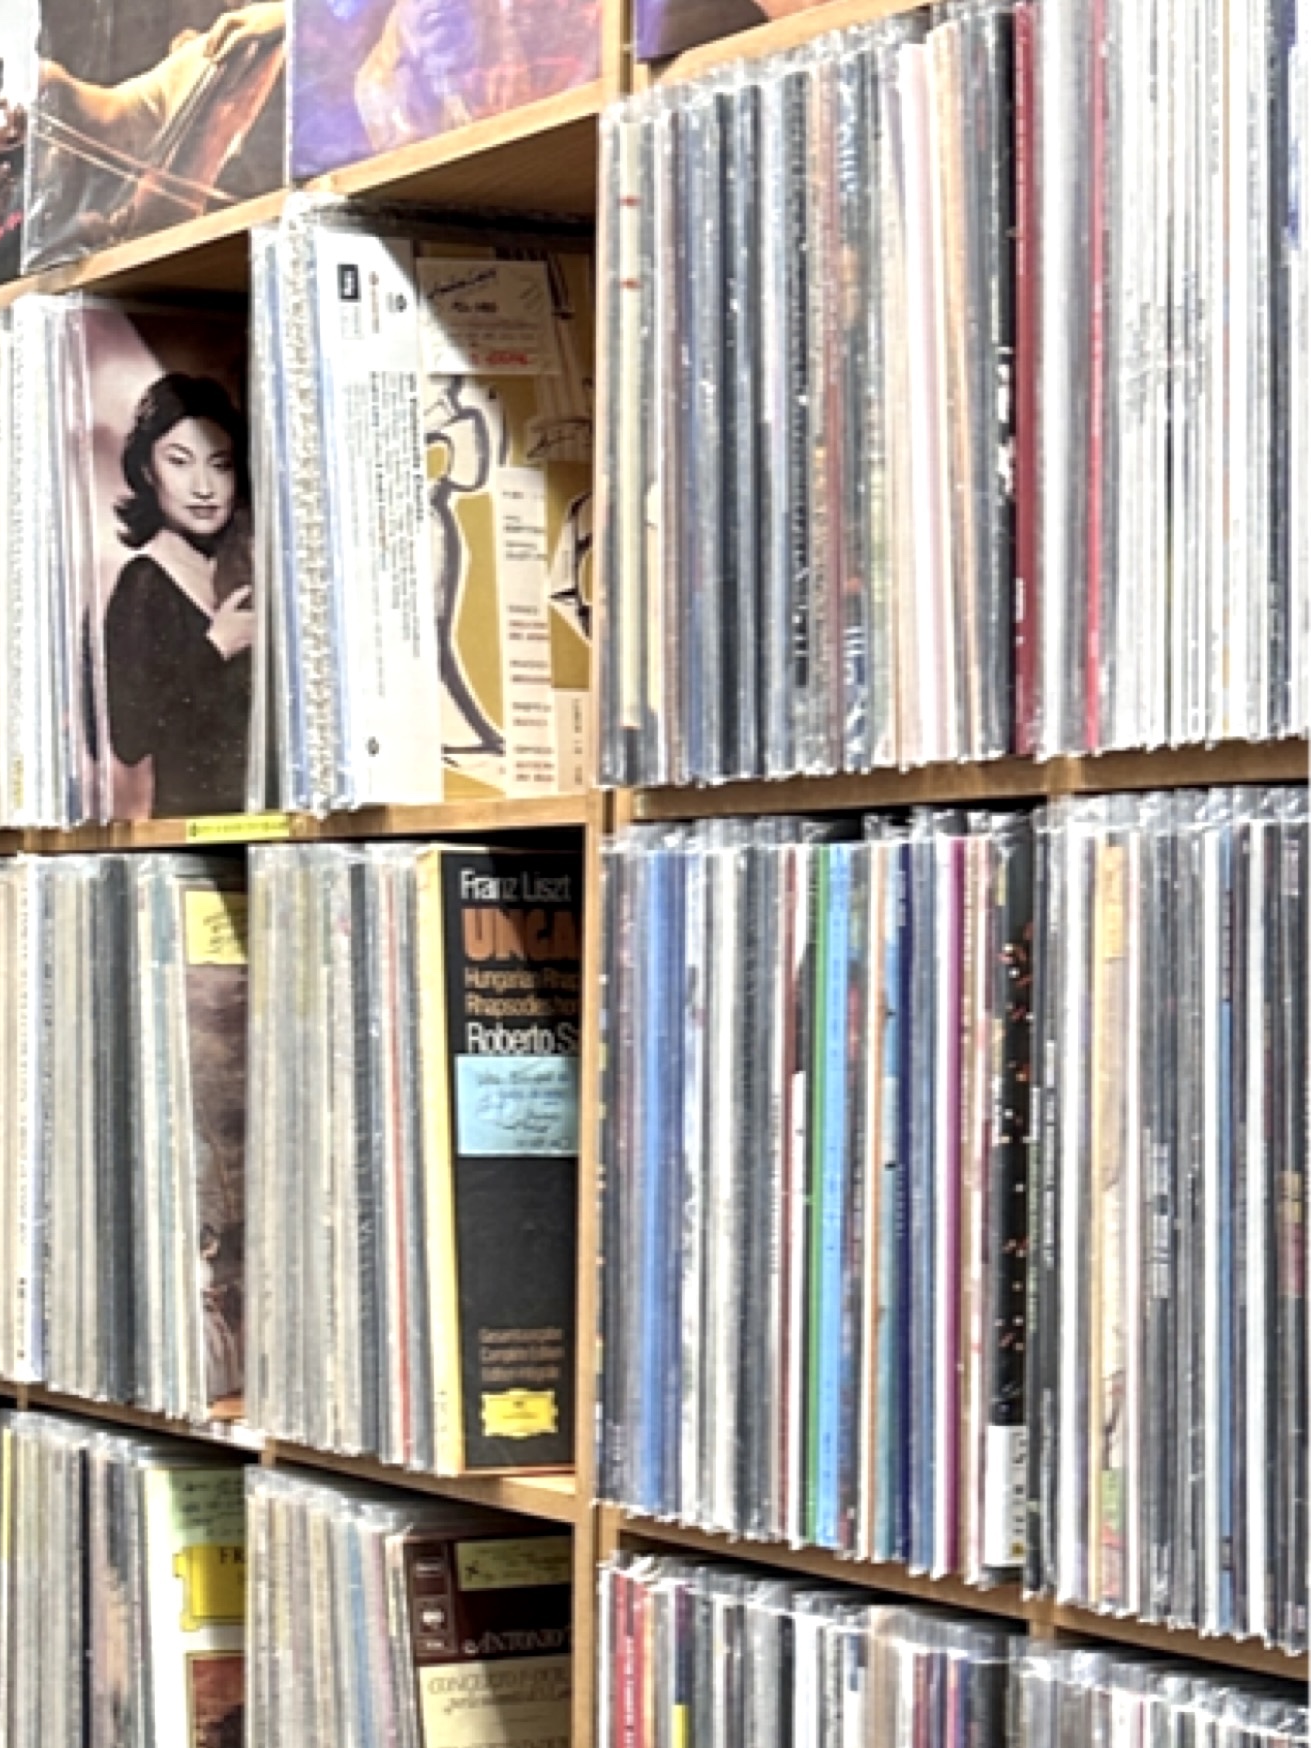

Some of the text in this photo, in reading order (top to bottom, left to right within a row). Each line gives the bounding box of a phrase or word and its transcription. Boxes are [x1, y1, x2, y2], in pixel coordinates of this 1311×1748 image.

[461, 868, 571, 902] Franz Liszt
[467, 1021, 555, 1055] Roberto
